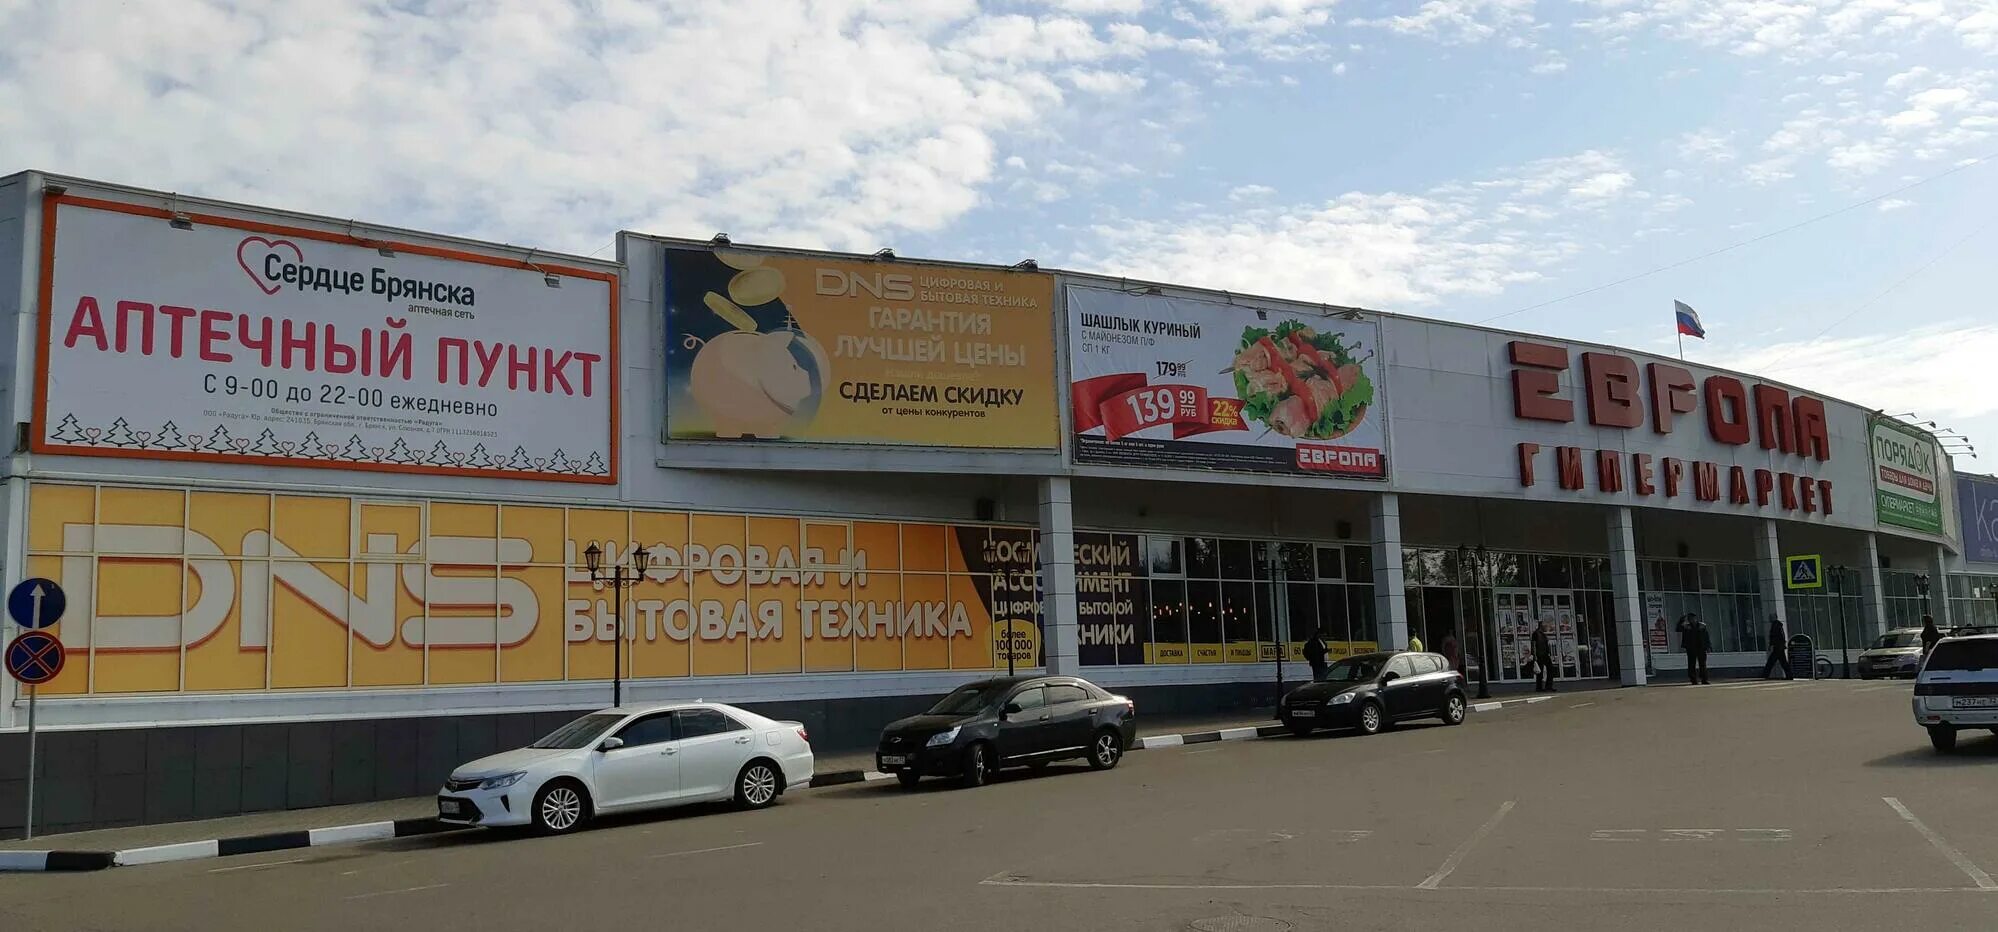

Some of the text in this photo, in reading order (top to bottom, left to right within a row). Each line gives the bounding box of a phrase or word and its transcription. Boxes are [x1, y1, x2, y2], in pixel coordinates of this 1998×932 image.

[264, 253, 475, 306] Сердце Брянска
[815, 268, 915, 301] DNS
[919, 276, 1004, 293] ЦИФРОВАЯ И
[408, 303, 475, 320] аптечная сеть
[920, 289, 1038, 309] БЫТОВАЯ ТЕХНИКА
[868, 305, 992, 336] ГАРАНТИЯ
[1081, 312, 1201, 339] ШАШЛЫК КУРИНЫЙ
[64, 295, 602, 398] АПТЕЧНЫЙ ПУНКТ
[1088, 330, 1139, 345] МАЙОНЕЗОМ
[1101, 345, 1111, 355] КГ
[834, 334, 1026, 369] ЛУЧШЕЙ ЦЕНЫ
[1156, 361, 1177, 377] 179
[204, 373, 498, 417] С 9-00 до 22-00 ежедневно
[839, 381, 1024, 408] СДЕЛАЕМ СКИДКУ
[1126, 388, 1196, 425] 139 99
[1508, 340, 1830, 462] ЕВРОПА
[881, 407, 986, 419] от цены конкурентов
[1180, 408, 1197, 417] РУБ
[1211, 416, 1238, 426] СКИДКА
[1212, 400, 1239, 417] 22%
[1299, 448, 1377, 468] ЕВРОПА
[1875, 436, 1932, 475] ПОРЯДОК
[1517, 442, 1834, 516] ГИПЕРМАРКЕТ
[567, 540, 867, 591] ЦИФРОВАЯ И
[61, 523, 540, 653] DNS
[567, 599, 973, 642] БЫТОВАЯ ТЕХНИКА
[1001, 629, 1026, 639] более
[1160, 649, 1183, 658] ДОСТАВКА
